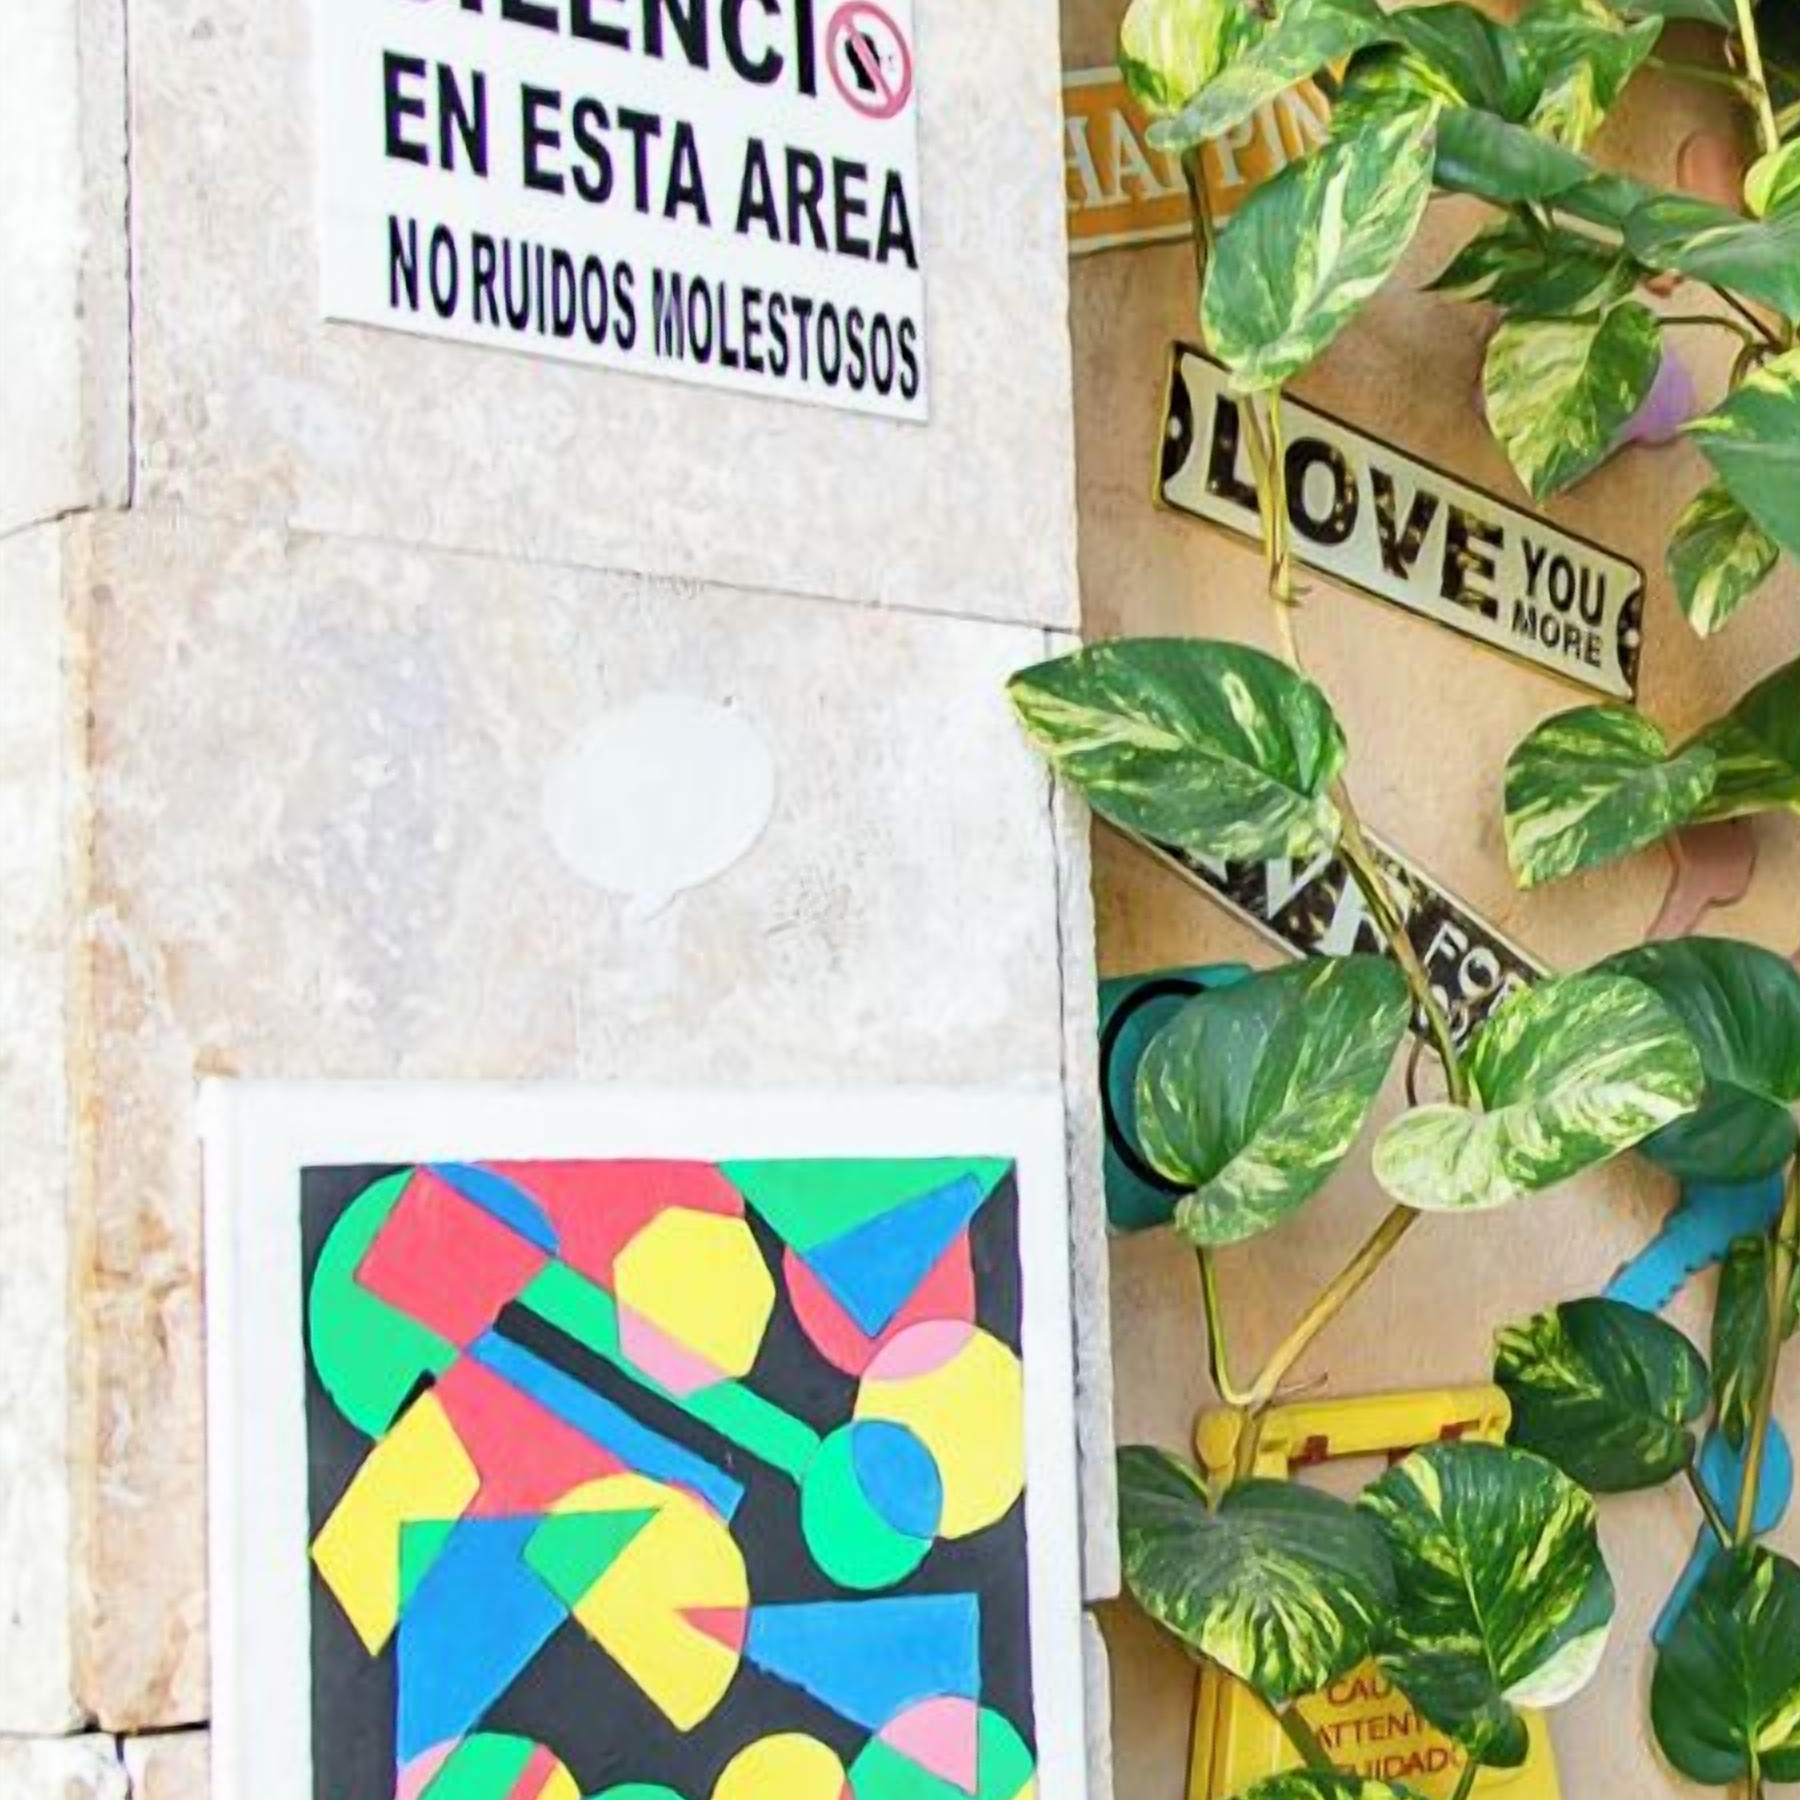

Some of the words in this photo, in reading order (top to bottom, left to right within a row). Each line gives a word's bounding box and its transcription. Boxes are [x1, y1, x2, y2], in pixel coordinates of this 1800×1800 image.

[382, 49, 488, 179] EN
[521, 81, 712, 228] ESTA
[735, 137, 919, 271] AREA
[388, 214, 459, 319] NO
[471, 231, 637, 351] RUIDOS
[652, 266, 920, 401] MOLESTOSOS
[1206, 394, 1504, 620] LOVE
[1520, 537, 1606, 627] YOU
[1511, 599, 1602, 668] MORE
